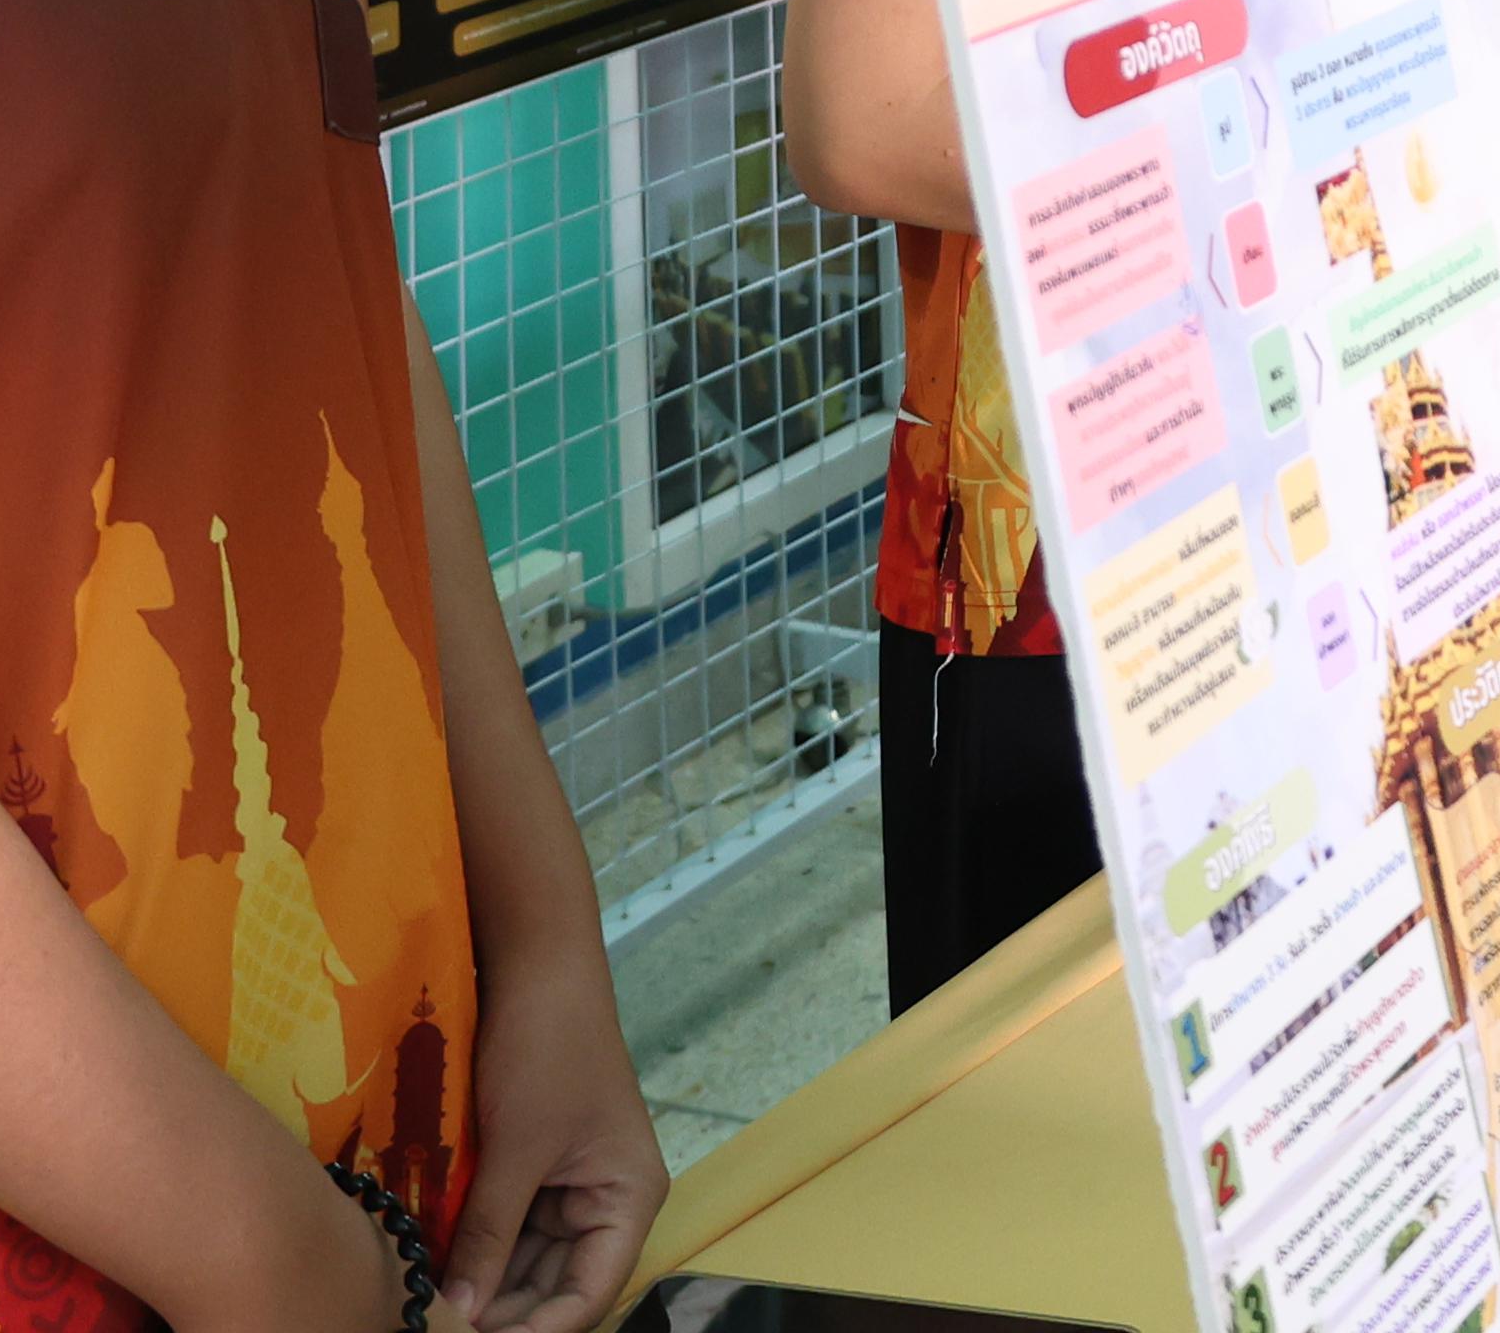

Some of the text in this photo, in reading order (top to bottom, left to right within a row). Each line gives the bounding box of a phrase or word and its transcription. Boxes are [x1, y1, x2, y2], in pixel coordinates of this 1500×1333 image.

[1118, 19, 1203, 83] องค์วัตถุ
[1183, 1005, 1210, 1075] 1
[1206, 1140, 1237, 1210] 2
